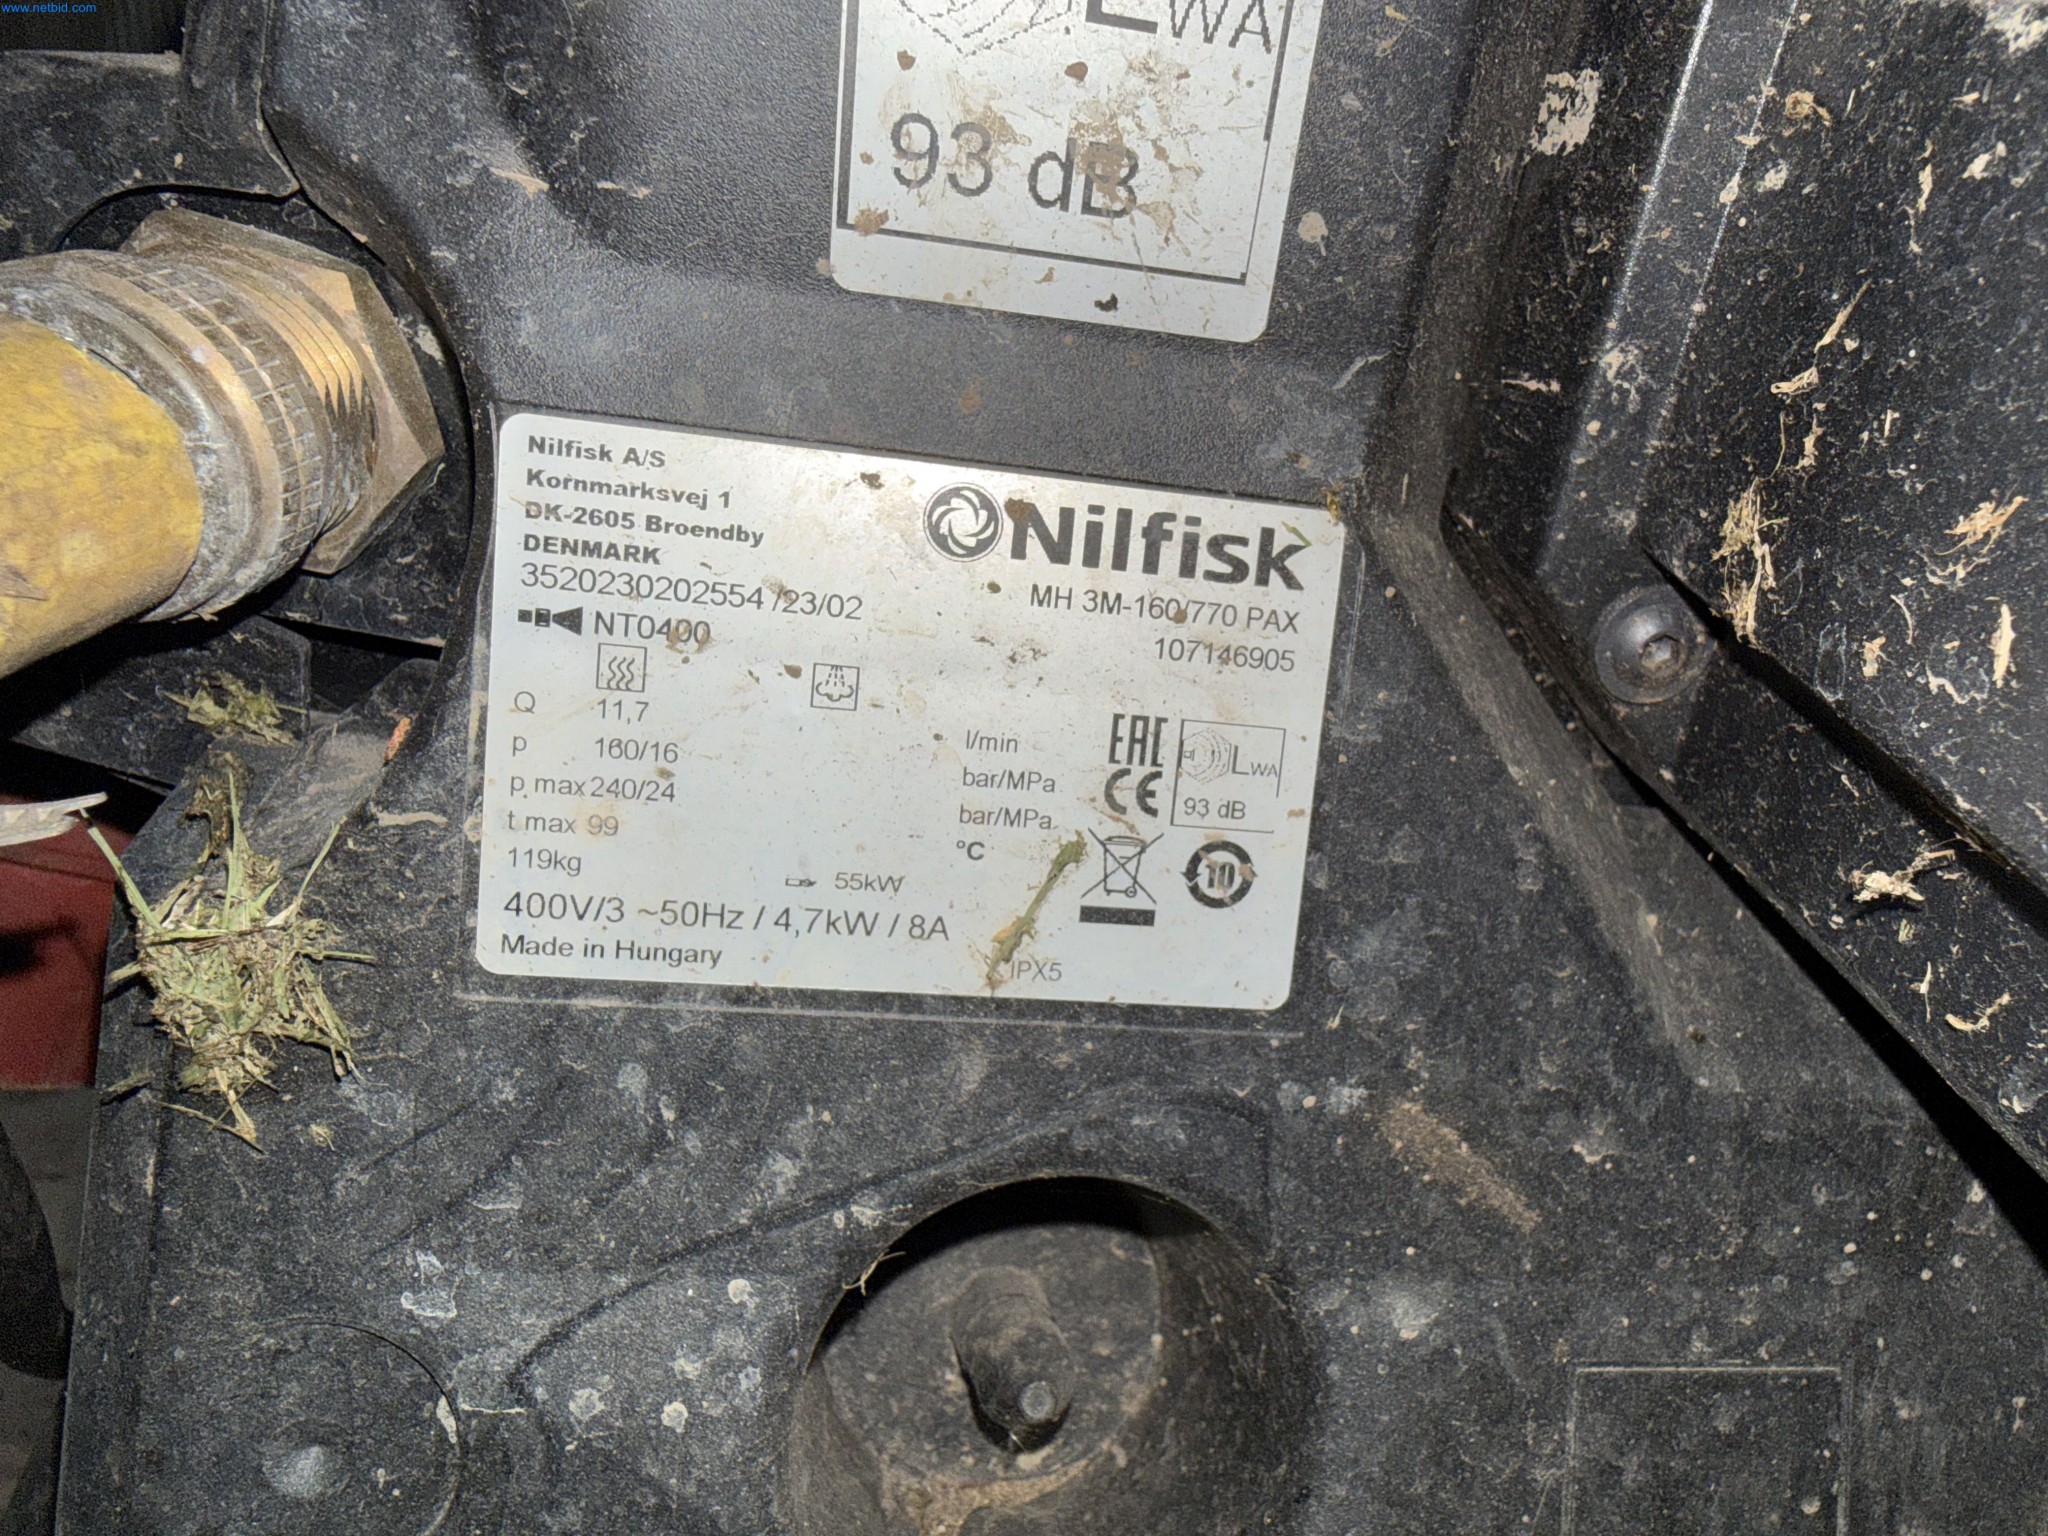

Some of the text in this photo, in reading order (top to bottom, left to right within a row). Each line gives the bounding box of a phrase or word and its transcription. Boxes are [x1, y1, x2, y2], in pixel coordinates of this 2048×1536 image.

[1085, 0, 1272, 54] WA
[890, 111, 1139, 219] 93 dB
[528, 435, 666, 468] Nilfisk A/S
[526, 468, 730, 510] Kornmarksvej 1
[525, 501, 764, 548] DK-2605 Broendby
[523, 533, 662, 565] DENMARK
[1009, 501, 1311, 591] Nilfisk
[521, 562, 863, 620] 3520230202554 /23/02
[1030, 583, 1300, 634] MH 3M-160/770 PAX
[594, 610, 711, 643] NT0400
[1155, 637, 1295, 672] 107146905
[514, 691, 649, 725] Q 11,7
[512, 735, 679, 763] p 160/16
[965, 729, 1019, 754] l/min
[1108, 713, 1169, 768] EAC
[510, 775, 675, 802] p max 240/24
[963, 766, 1056, 793] bar/MPa
[1104, 768, 1163, 818] CE
[507, 810, 619, 836] t max 99
[959, 804, 1052, 830] bar/MPa
[1183, 797, 1246, 820] 93 dB
[508, 847, 582, 877] 119kg
[956, 840, 985, 861] °C
[834, 872, 906, 895] 55kW
[1205, 861, 1236, 889] 10
[503, 891, 949, 941] 400V/3 ~50Hz / 4,7kW / 8A
[500, 934, 723, 967] Made in Hungary
[1011, 960, 1062, 981] IPX5
